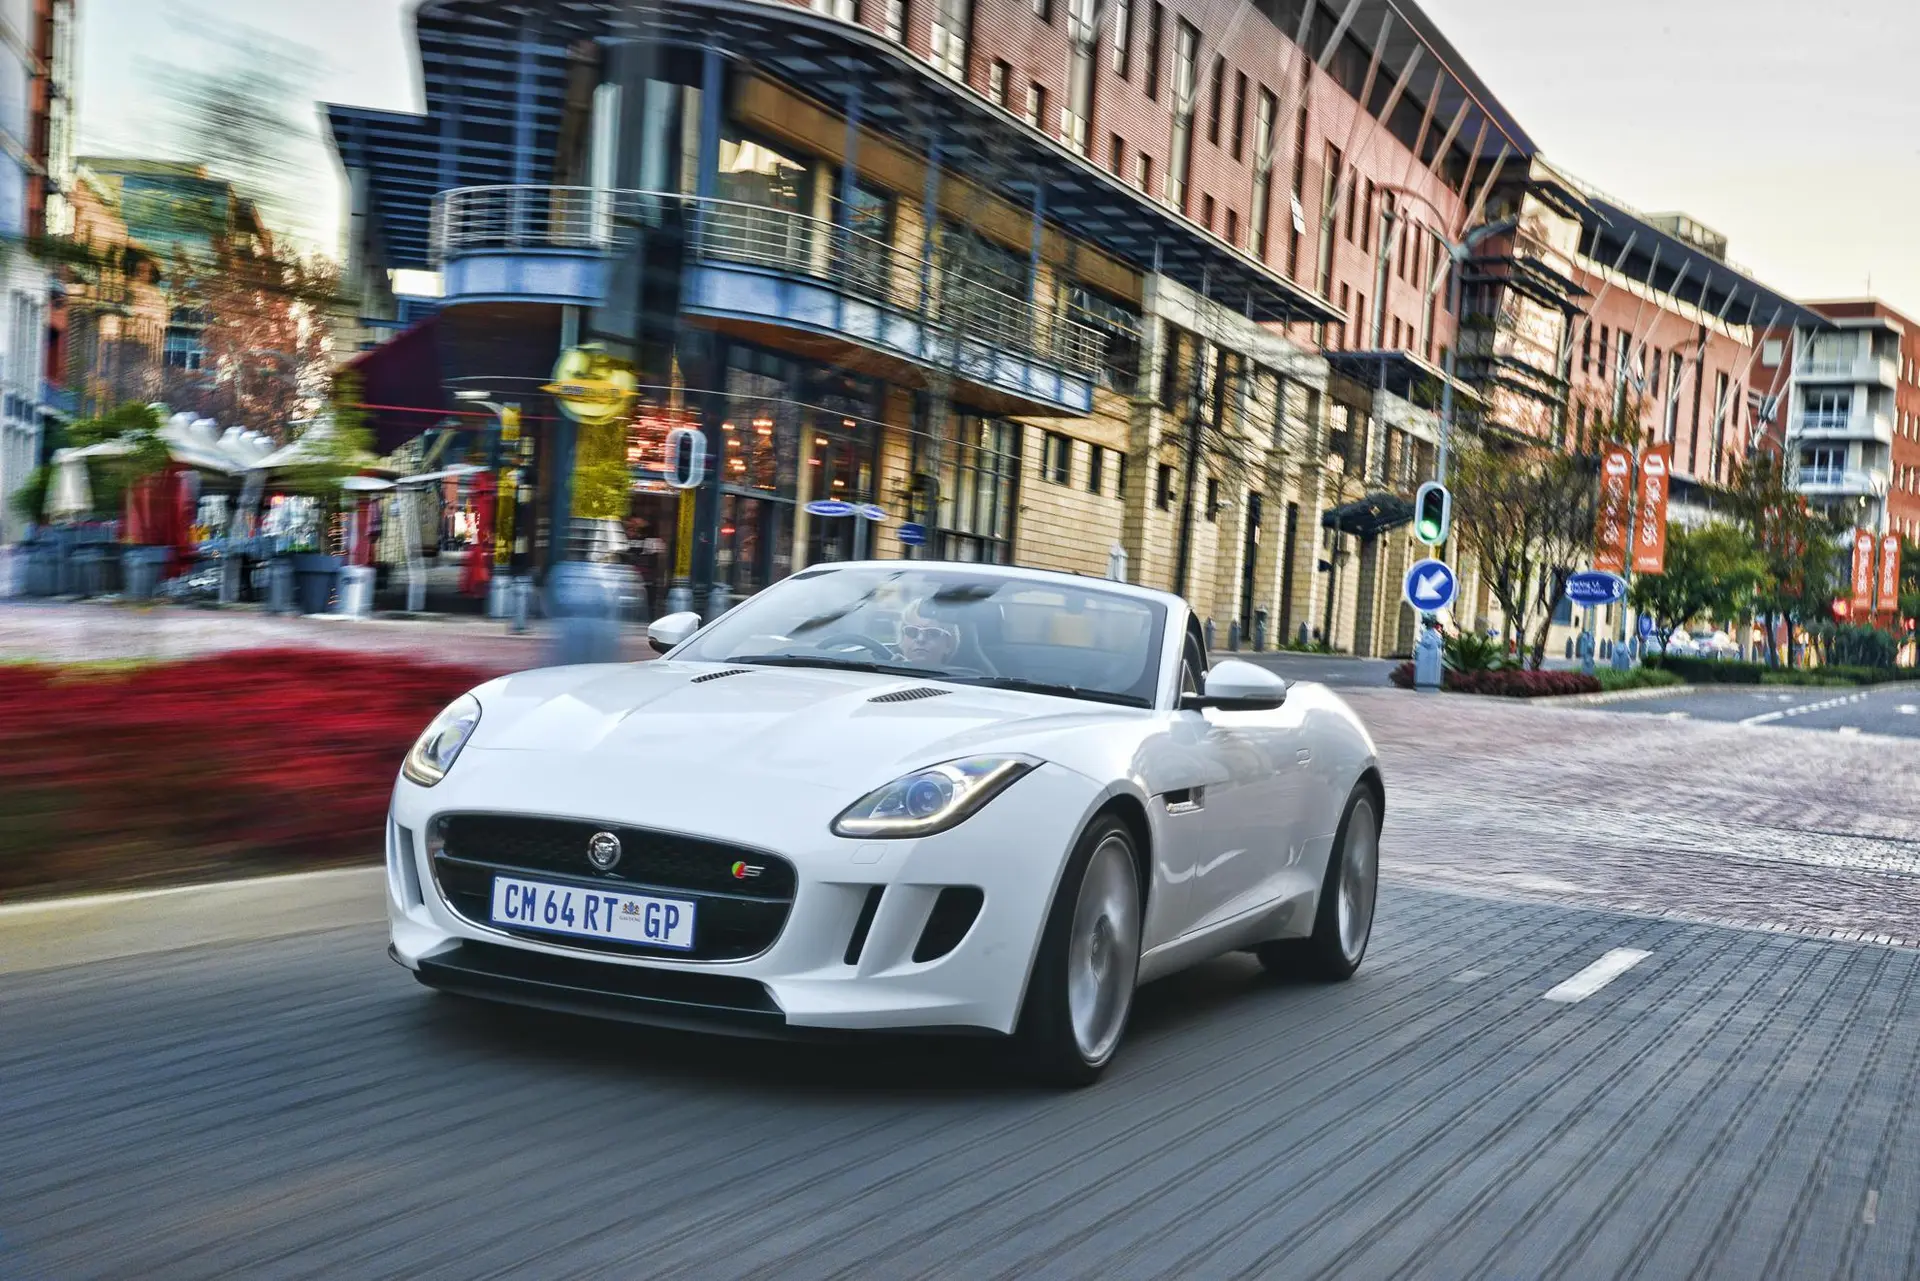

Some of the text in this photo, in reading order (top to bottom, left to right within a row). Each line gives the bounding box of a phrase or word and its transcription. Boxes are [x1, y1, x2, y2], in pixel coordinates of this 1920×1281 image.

[504, 883, 680, 940] CM 64 RT GP
